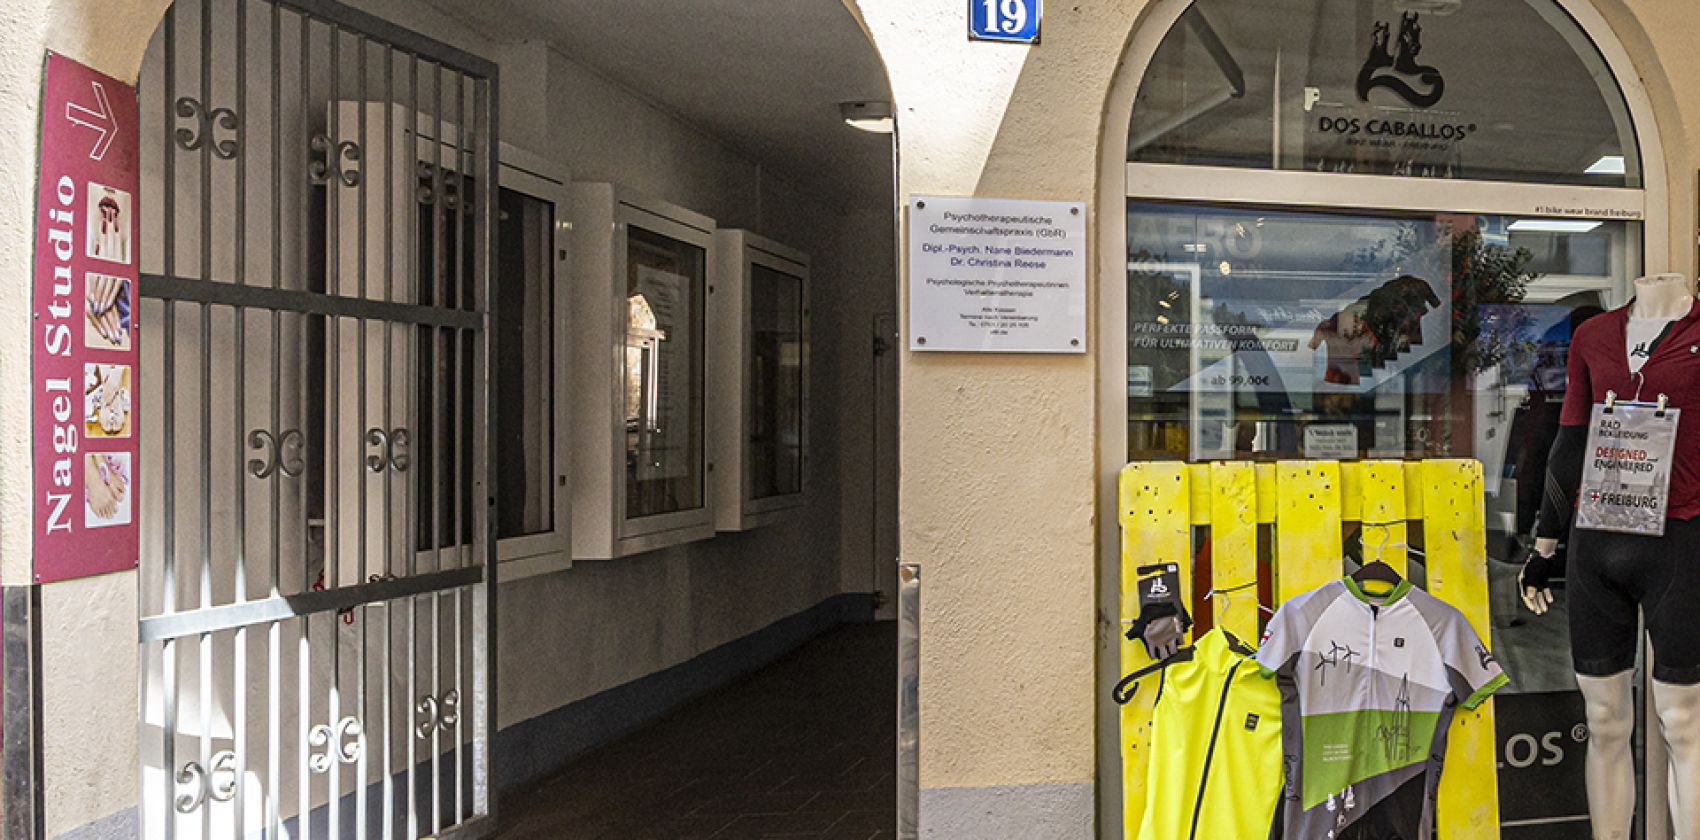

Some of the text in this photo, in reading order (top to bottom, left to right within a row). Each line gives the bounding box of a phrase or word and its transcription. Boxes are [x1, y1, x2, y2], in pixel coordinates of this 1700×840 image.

[983, 0, 1027, 33] 19
[1319, 116, 1361, 134] DOS
[943, 211, 1053, 225] Psychotherapeutische
[1585, 207, 1609, 216] brand
[929, 224, 1034, 238] Gemeinschaftspraxis
[1014, 246, 1074, 258] Biedermann
[950, 256, 966, 267] Dr.
[967, 257, 1012, 268] Christina
[1134, 322, 1195, 336] PERFEKTE
[1133, 335, 1160, 348] FÜR
[45, 174, 79, 535] Nagel Studio
[1600, 419, 1622, 429] RAD
[1594, 459, 1655, 473] ENGINEERED
[1600, 491, 1658, 509] FREIBURG
